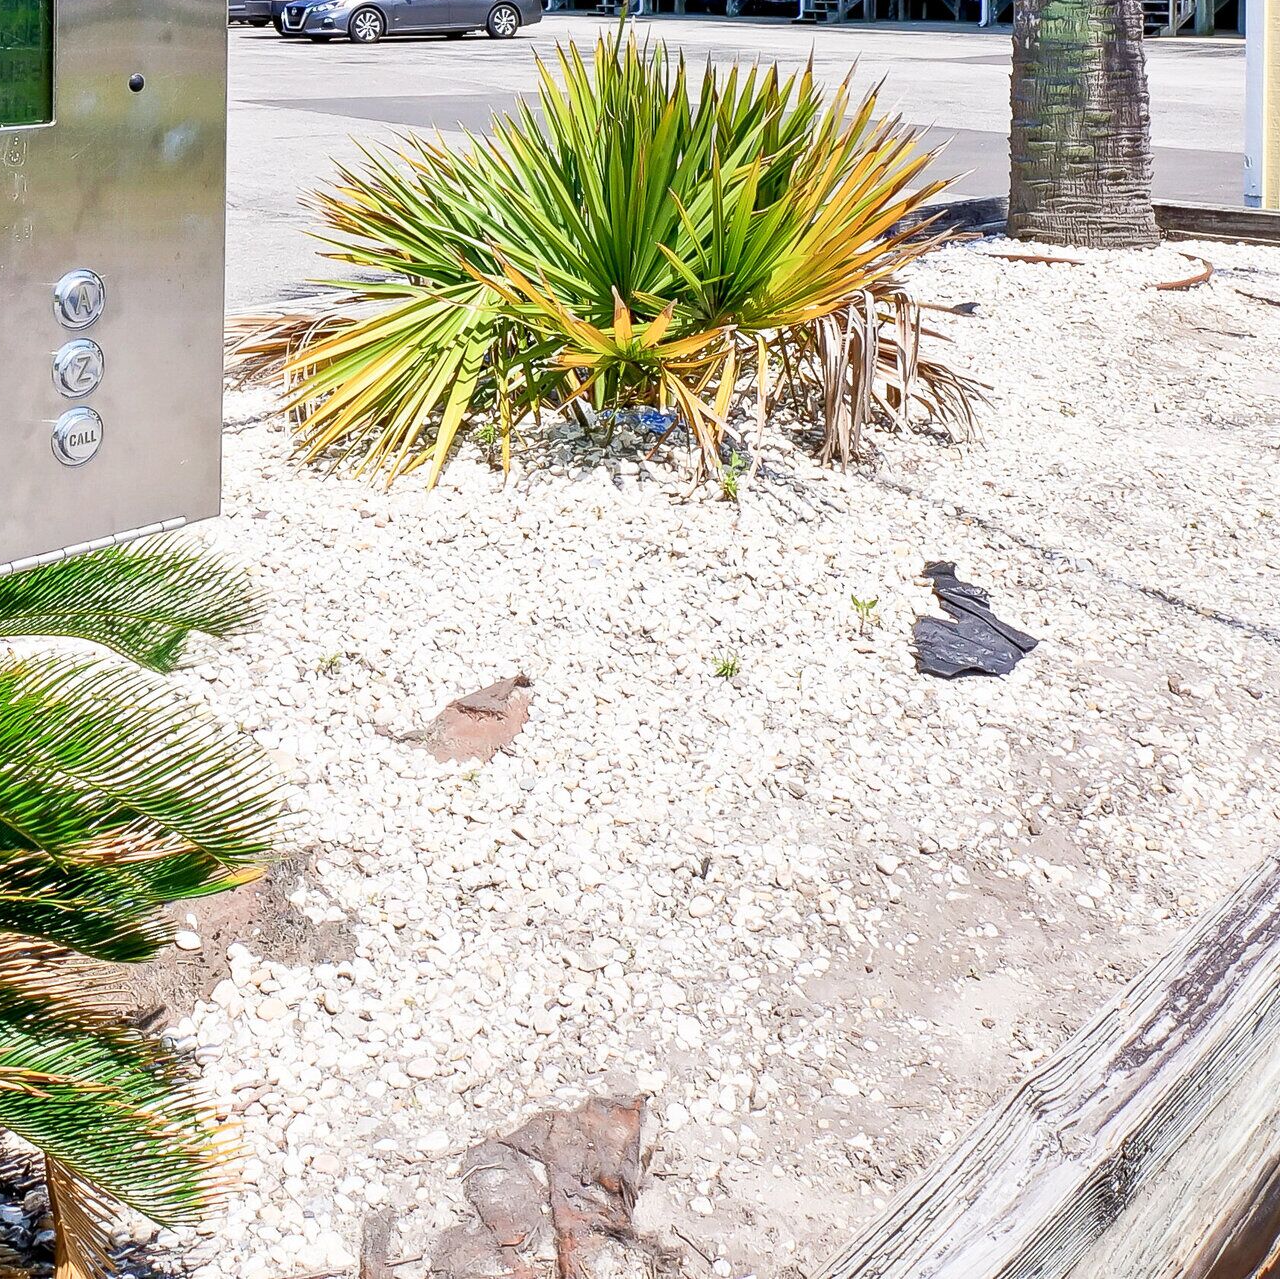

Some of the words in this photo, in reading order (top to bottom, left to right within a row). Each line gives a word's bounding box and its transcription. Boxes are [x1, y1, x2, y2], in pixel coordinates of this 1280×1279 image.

[76, 287, 92, 315] A
[77, 356, 91, 383] Z
[70, 430, 97, 447] CALL
